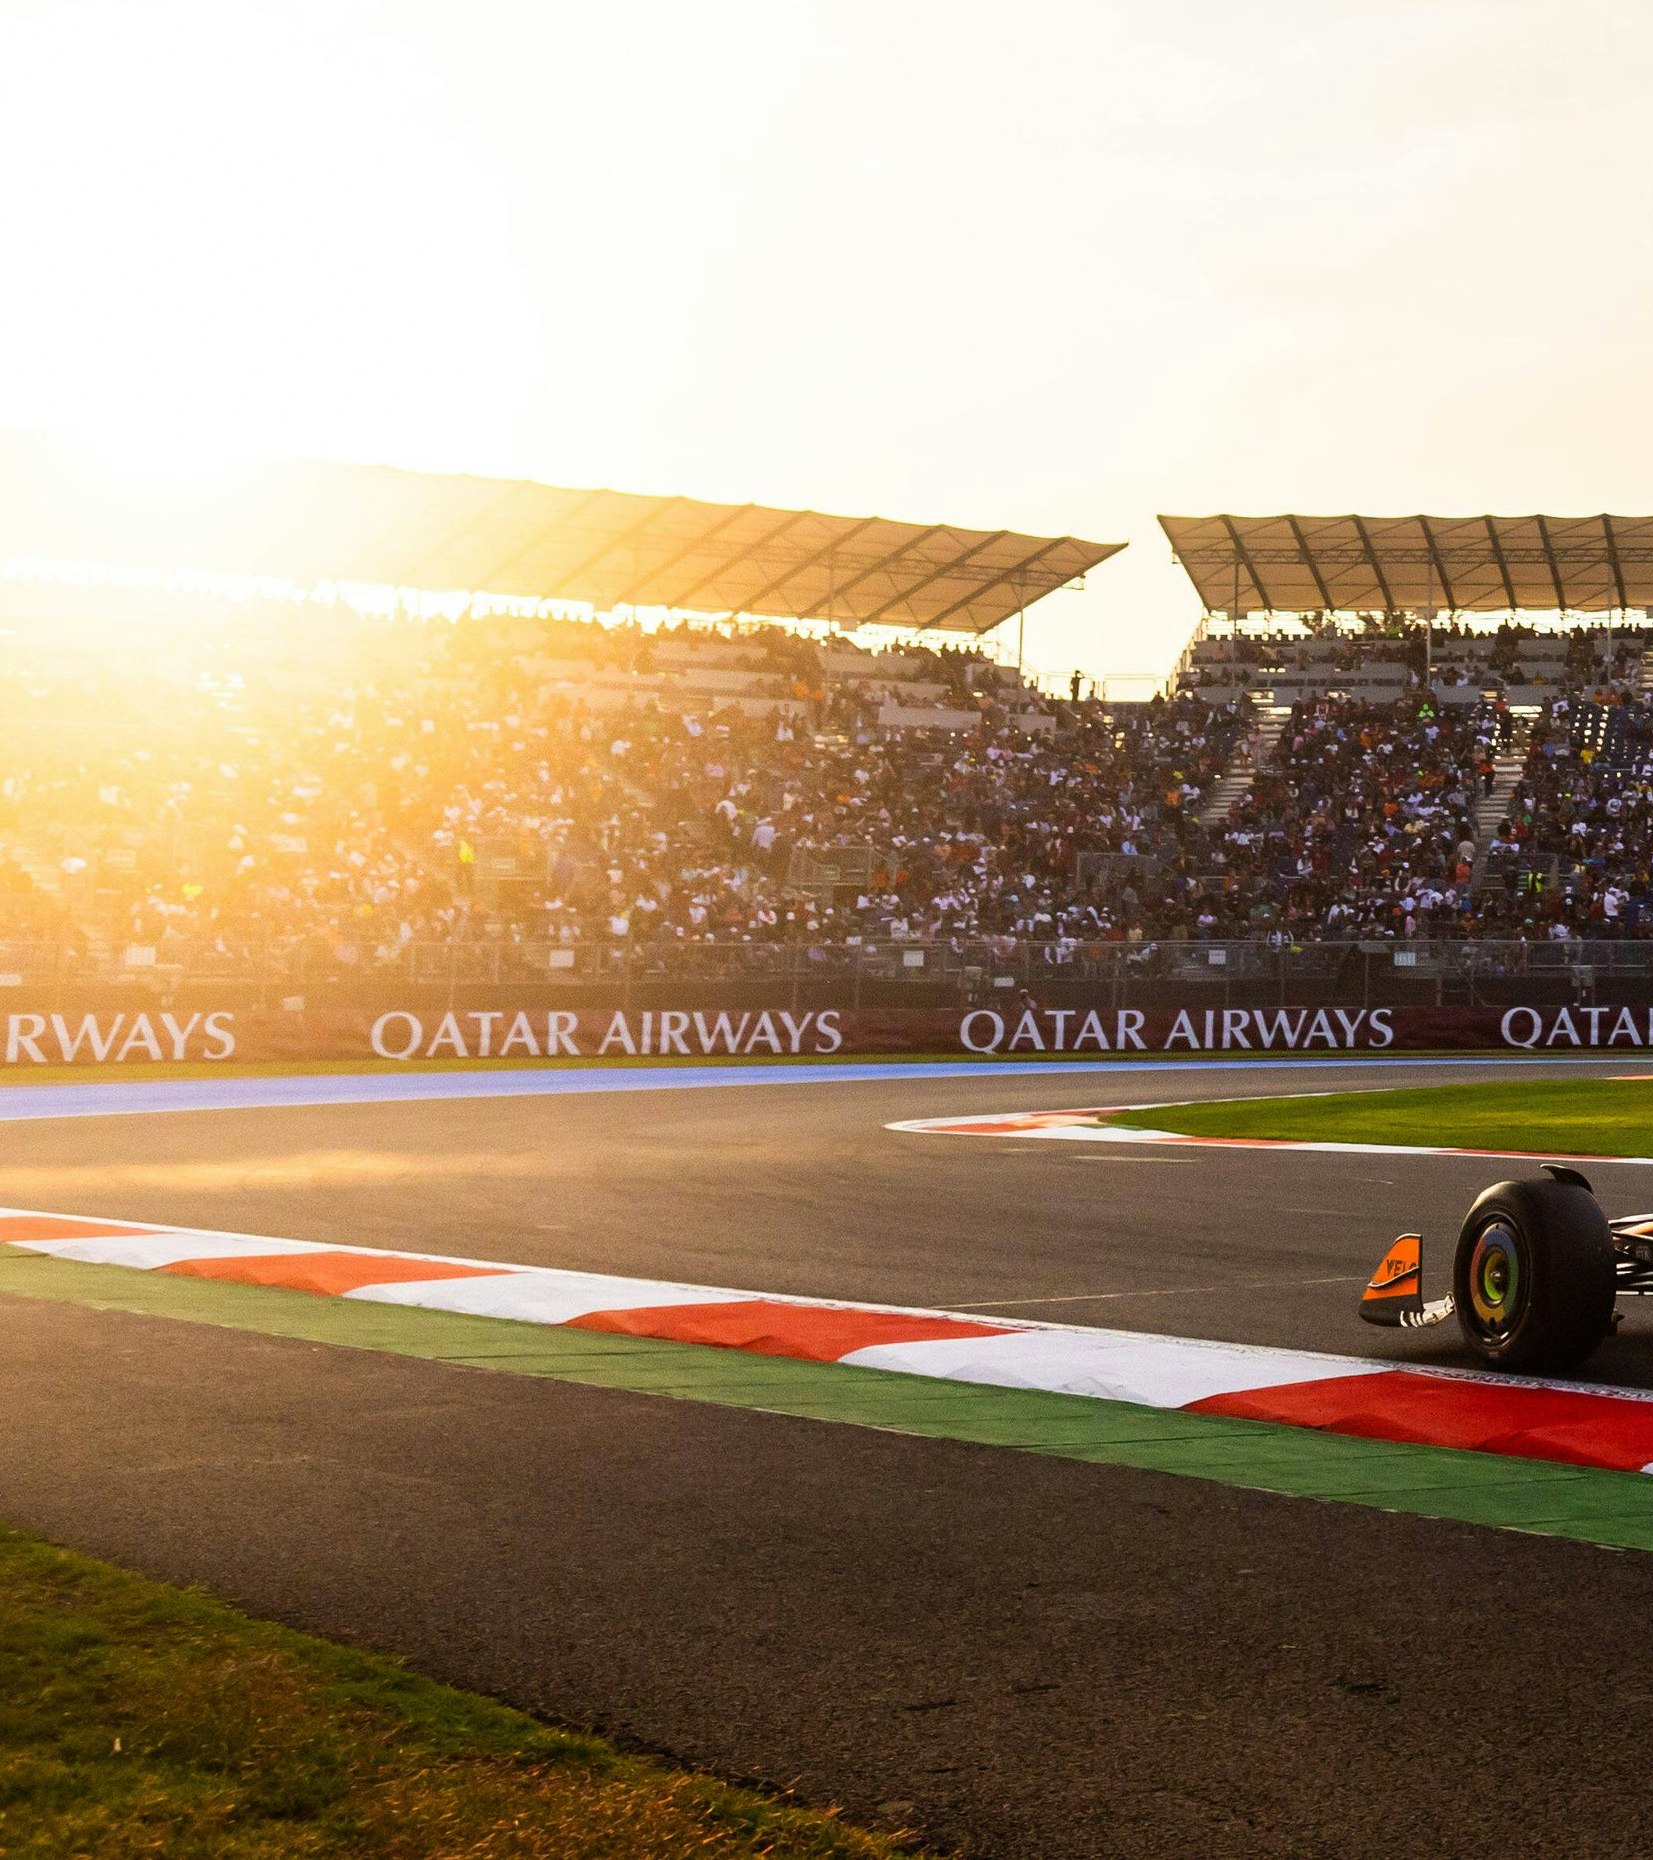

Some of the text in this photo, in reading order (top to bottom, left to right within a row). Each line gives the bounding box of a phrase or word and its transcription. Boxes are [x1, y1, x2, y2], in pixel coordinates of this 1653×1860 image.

[371, 1010, 842, 1060] QATAR AIRWAYS
[960, 1008, 1394, 1054] QATAR AIRWAYS
